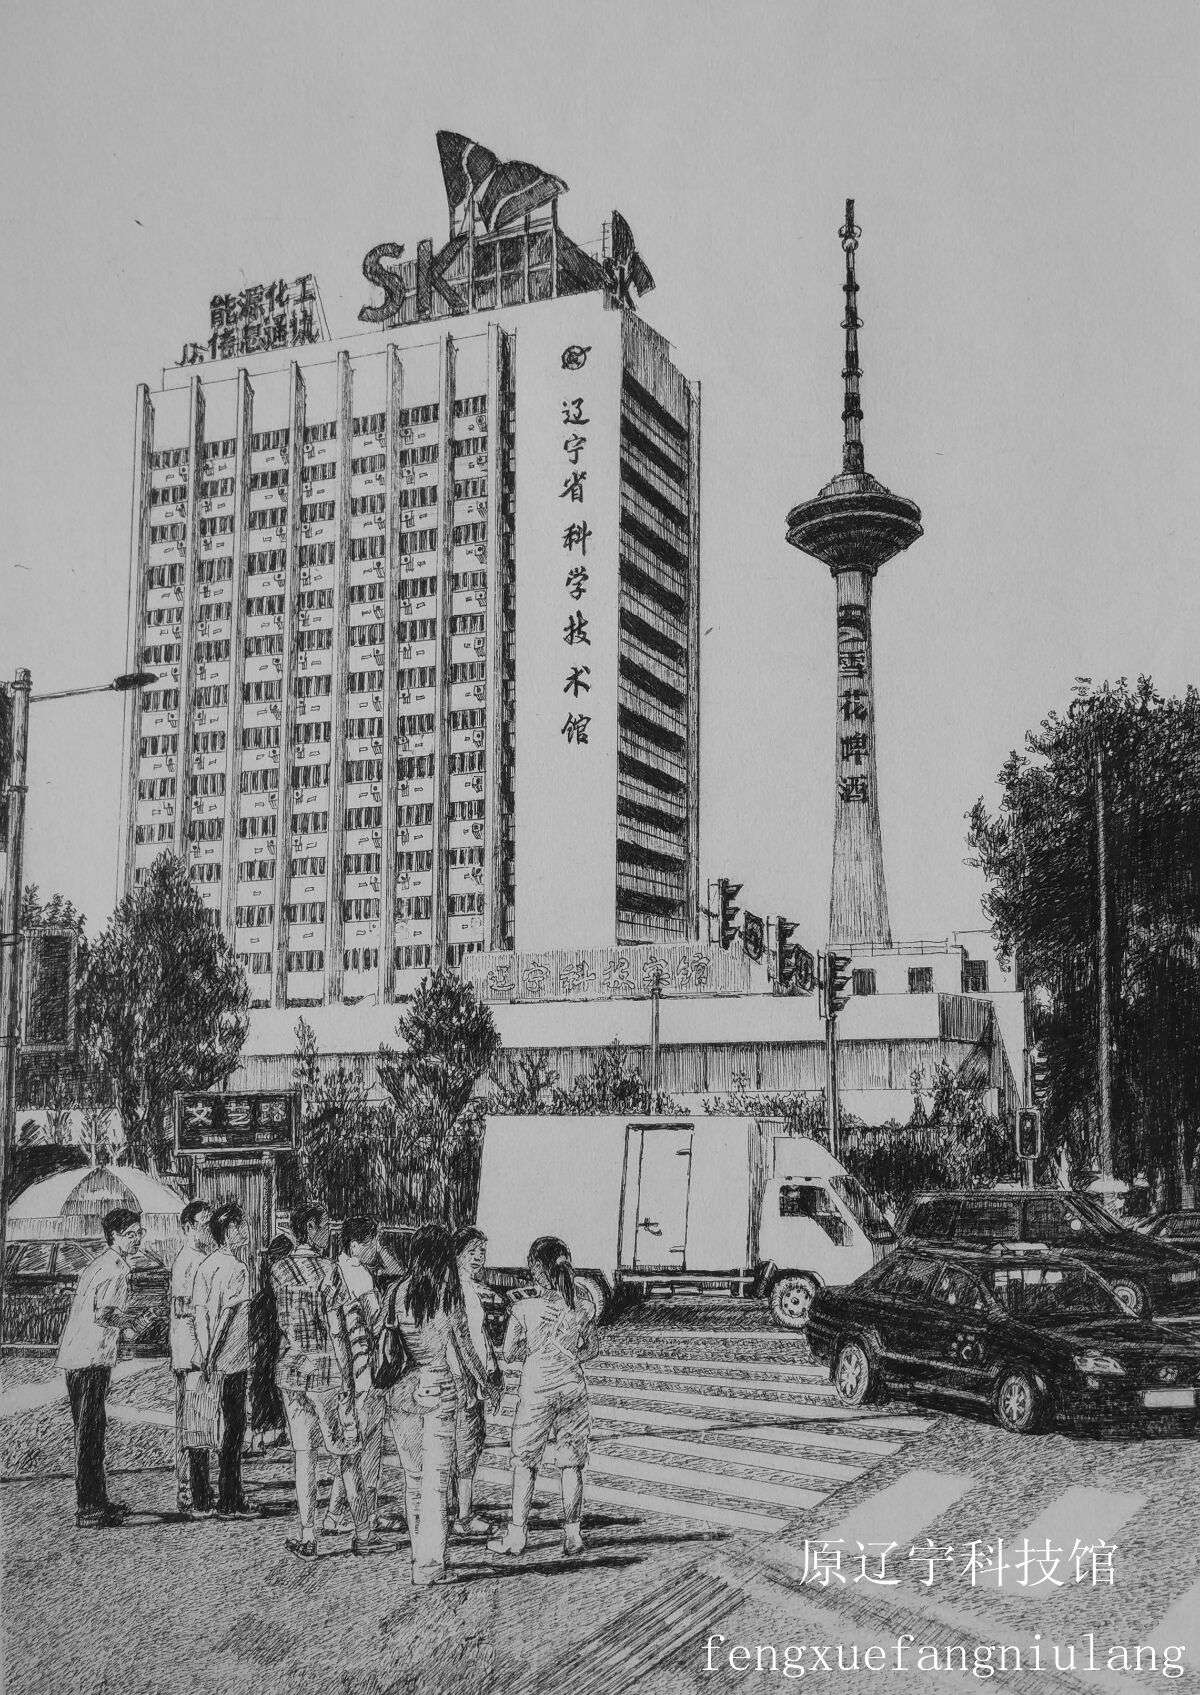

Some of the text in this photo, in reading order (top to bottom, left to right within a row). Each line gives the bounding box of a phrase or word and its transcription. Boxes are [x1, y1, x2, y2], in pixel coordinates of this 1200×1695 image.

[558, 397, 592, 745] 辽宁省科学技术馆
[838, 651, 870, 803] 雪花啤酒
[185, 1101, 288, 1126] 文艺路
